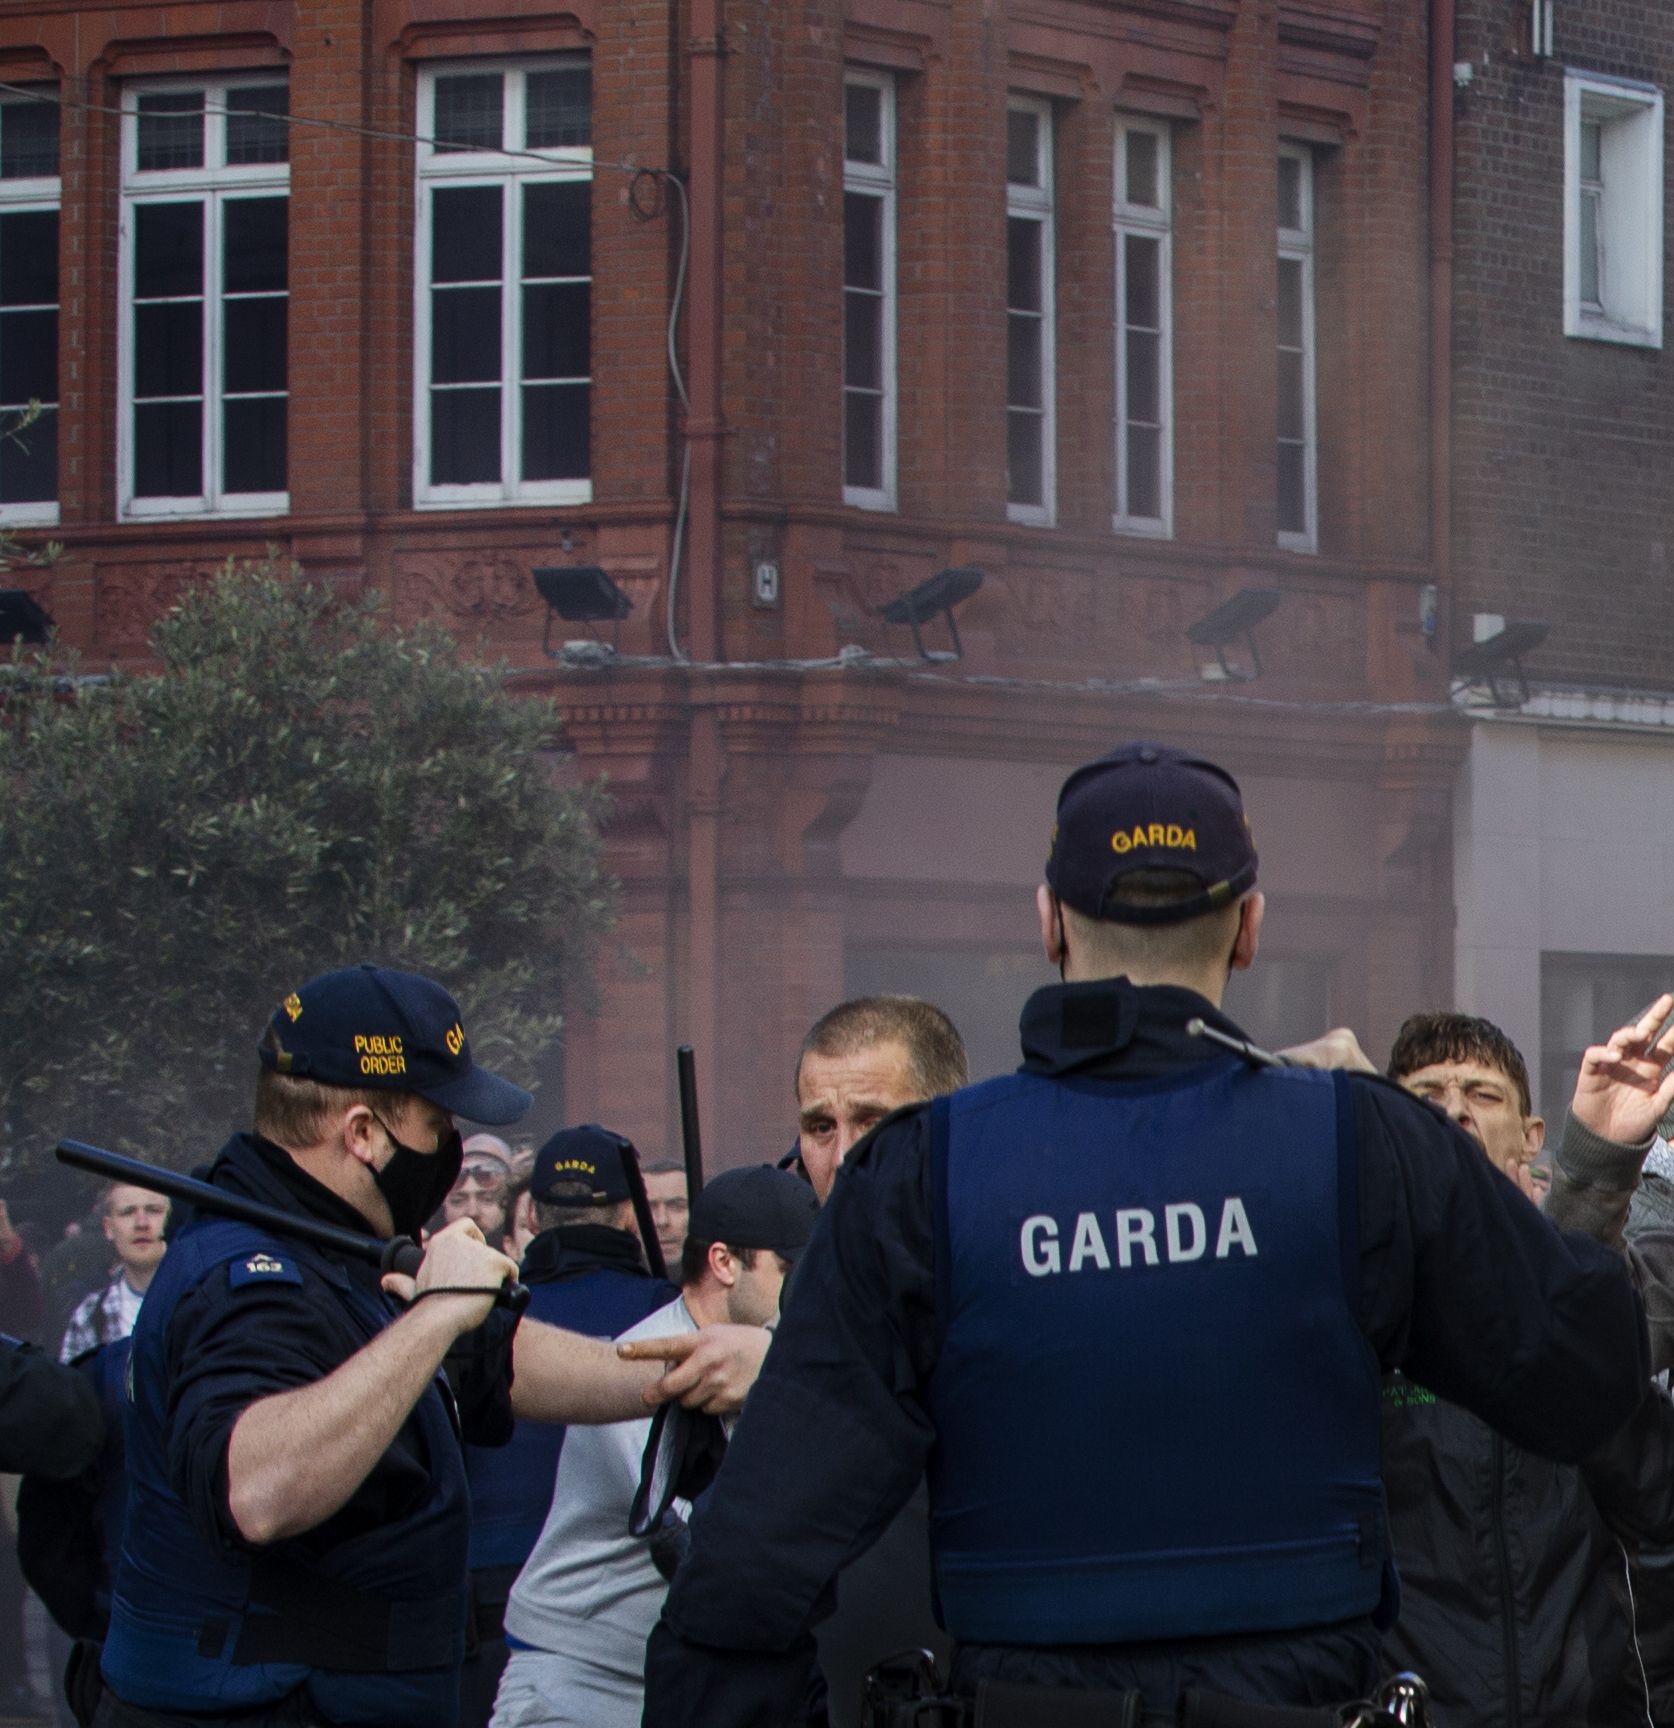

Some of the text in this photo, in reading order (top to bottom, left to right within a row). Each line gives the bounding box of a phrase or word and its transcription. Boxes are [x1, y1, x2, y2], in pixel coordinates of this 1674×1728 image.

[1110, 822, 1198, 854] GARDA
[354, 1034, 403, 1055] PUBLIC
[360, 1055, 406, 1075] ORDER
[554, 1159, 597, 1175] GARDA
[1020, 1197, 1259, 1278] GARDA
